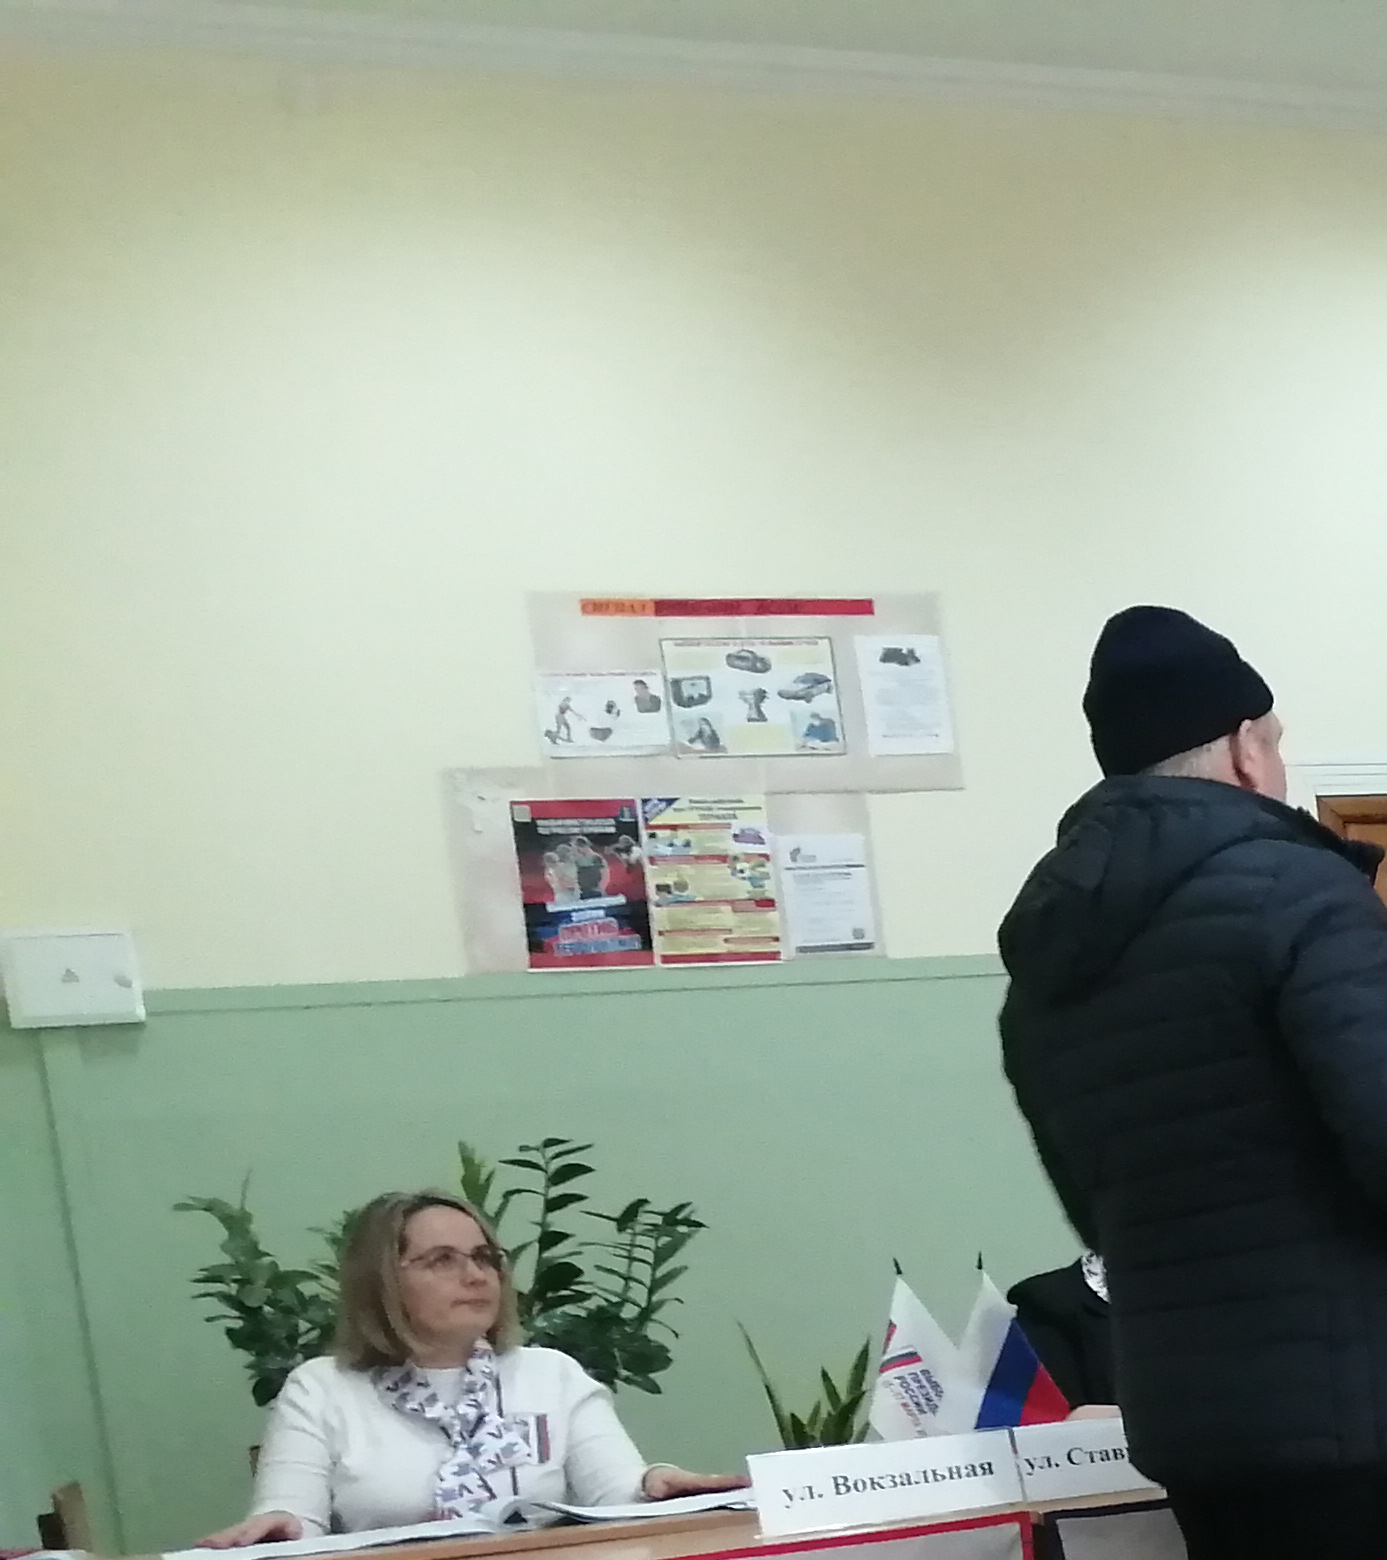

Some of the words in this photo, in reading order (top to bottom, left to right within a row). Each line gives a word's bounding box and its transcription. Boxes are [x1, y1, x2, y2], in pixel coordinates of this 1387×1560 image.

[1023, 1455, 1061, 1477] ул.
[1066, 1446, 1129, 1467] Став
[782, 1484, 824, 1509] ул.
[832, 1460, 995, 1496] Вокзальная
